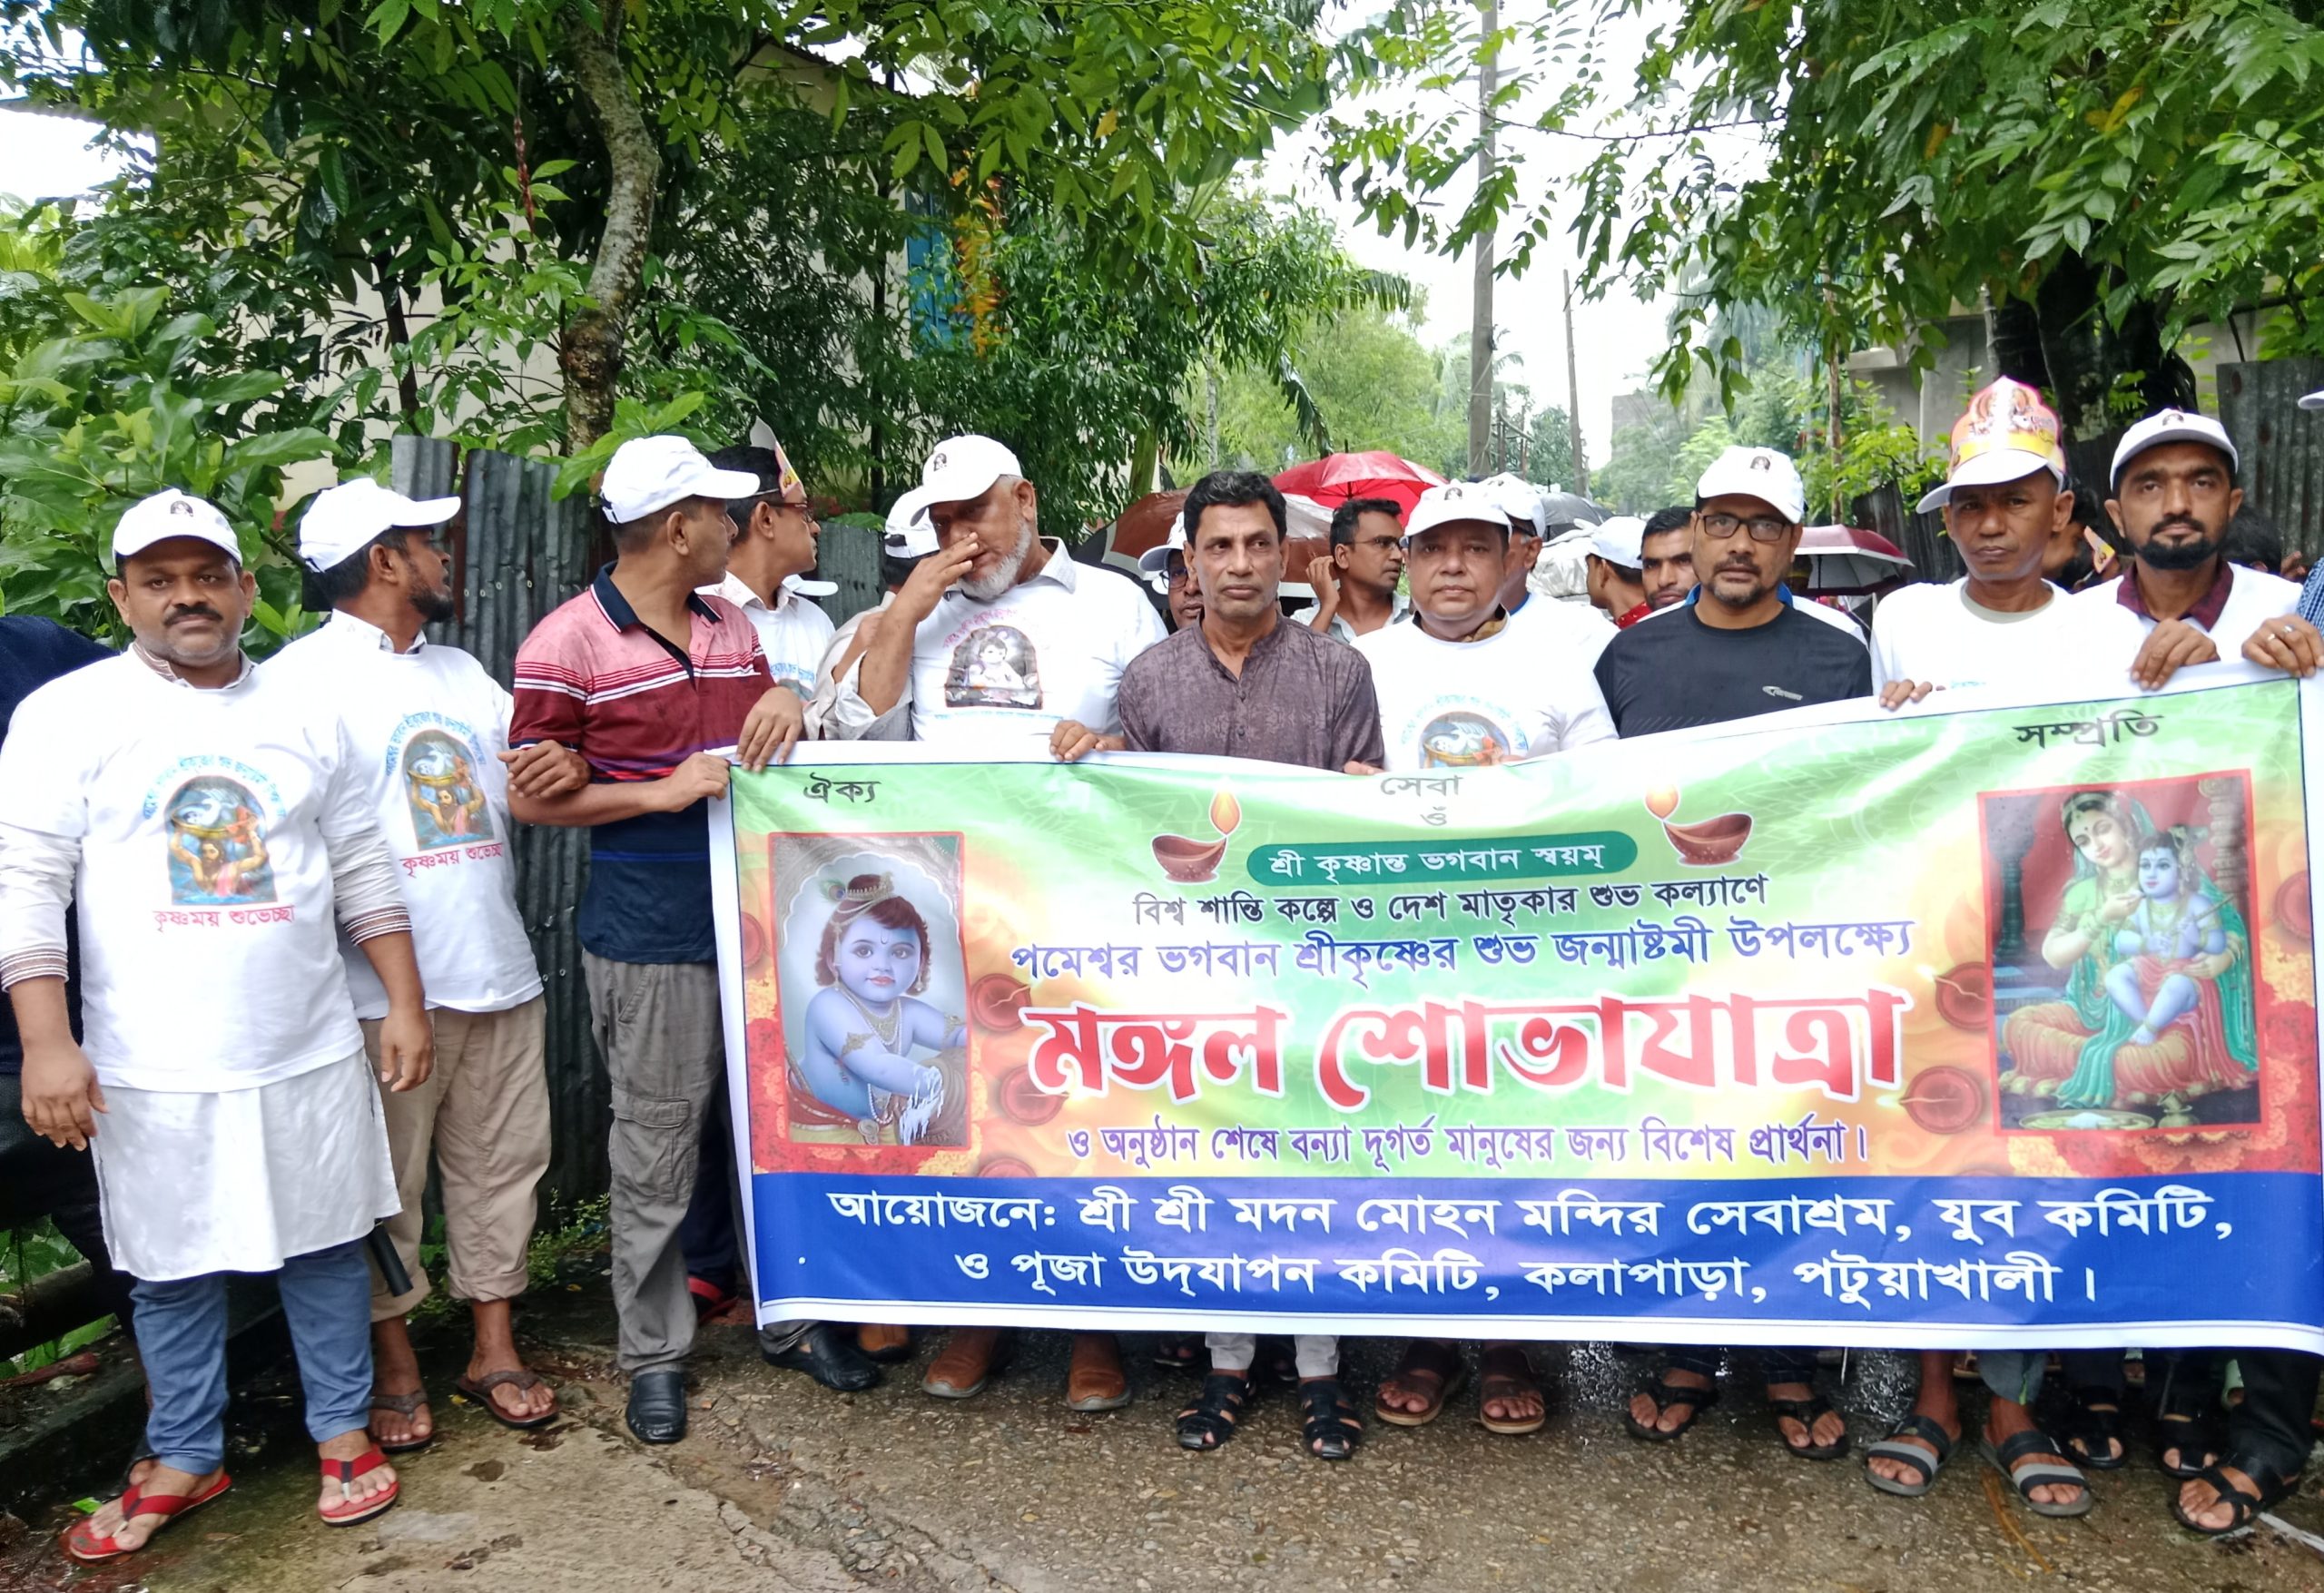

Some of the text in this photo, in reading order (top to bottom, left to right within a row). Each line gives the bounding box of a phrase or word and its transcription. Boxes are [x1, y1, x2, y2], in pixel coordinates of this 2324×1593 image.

[2012, 709, 2165, 749] সম্প্রতি
[803, 772, 882, 804] ঐক্য
[1381, 774, 1464, 797] সেবা
[466, 842, 504, 861] শুভেচ্ছ
[1269, 849, 1306, 878] শ্রী
[1418, 848, 1522, 874] ভগবান
[153, 903, 297, 934] কৃষ্ণময় শুভেচ্ছা
[1133, 872, 1771, 929] বিশ্ব শান্তি কল্পে ও দেশ মাতৃকার শুভ কল্যাণে
[1011, 914, 1915, 989] পমেশ্বর ভগবান শ্রীকৃষ্ণের শুভ জন্মাষ্টমী উপলক্ষ্যে
[1022, 987, 1907, 1110] মঙ্গল শোভাযাত্রা
[1068, 1129, 1090, 1159] ও
[1100, 1114, 1200, 1169] অনুষ্ঠান
[1211, 1126, 1278, 1161] শেষে
[1288, 1125, 1354, 1164] বন্যা
[1443, 1123, 1556, 1170] মানুষের
[1565, 1128, 1630, 1163] জন্য
[1640, 1116, 1737, 1164] বিশেষ
[1076, 1185, 1139, 1234] শ্রী
[1151, 1185, 1215, 1234] শ্রী
[1226, 1195, 1338, 1235] মদন
[1355, 1194, 1502, 1240] মোহন
[1513, 1187, 1667, 1237] মন্দির
[1685, 1193, 1913, 1244] সেবাশ্রম,
[1931, 1197, 2023, 1246] যুব
[2036, 1184, 2233, 1241] কমিটি,
[954, 1253, 990, 1281] ও
[1009, 1249, 1108, 1297] পূজা
[1335, 1246, 1501, 1303] কমিটি,
[1518, 1255, 1768, 1305] কলাপাড়া,
